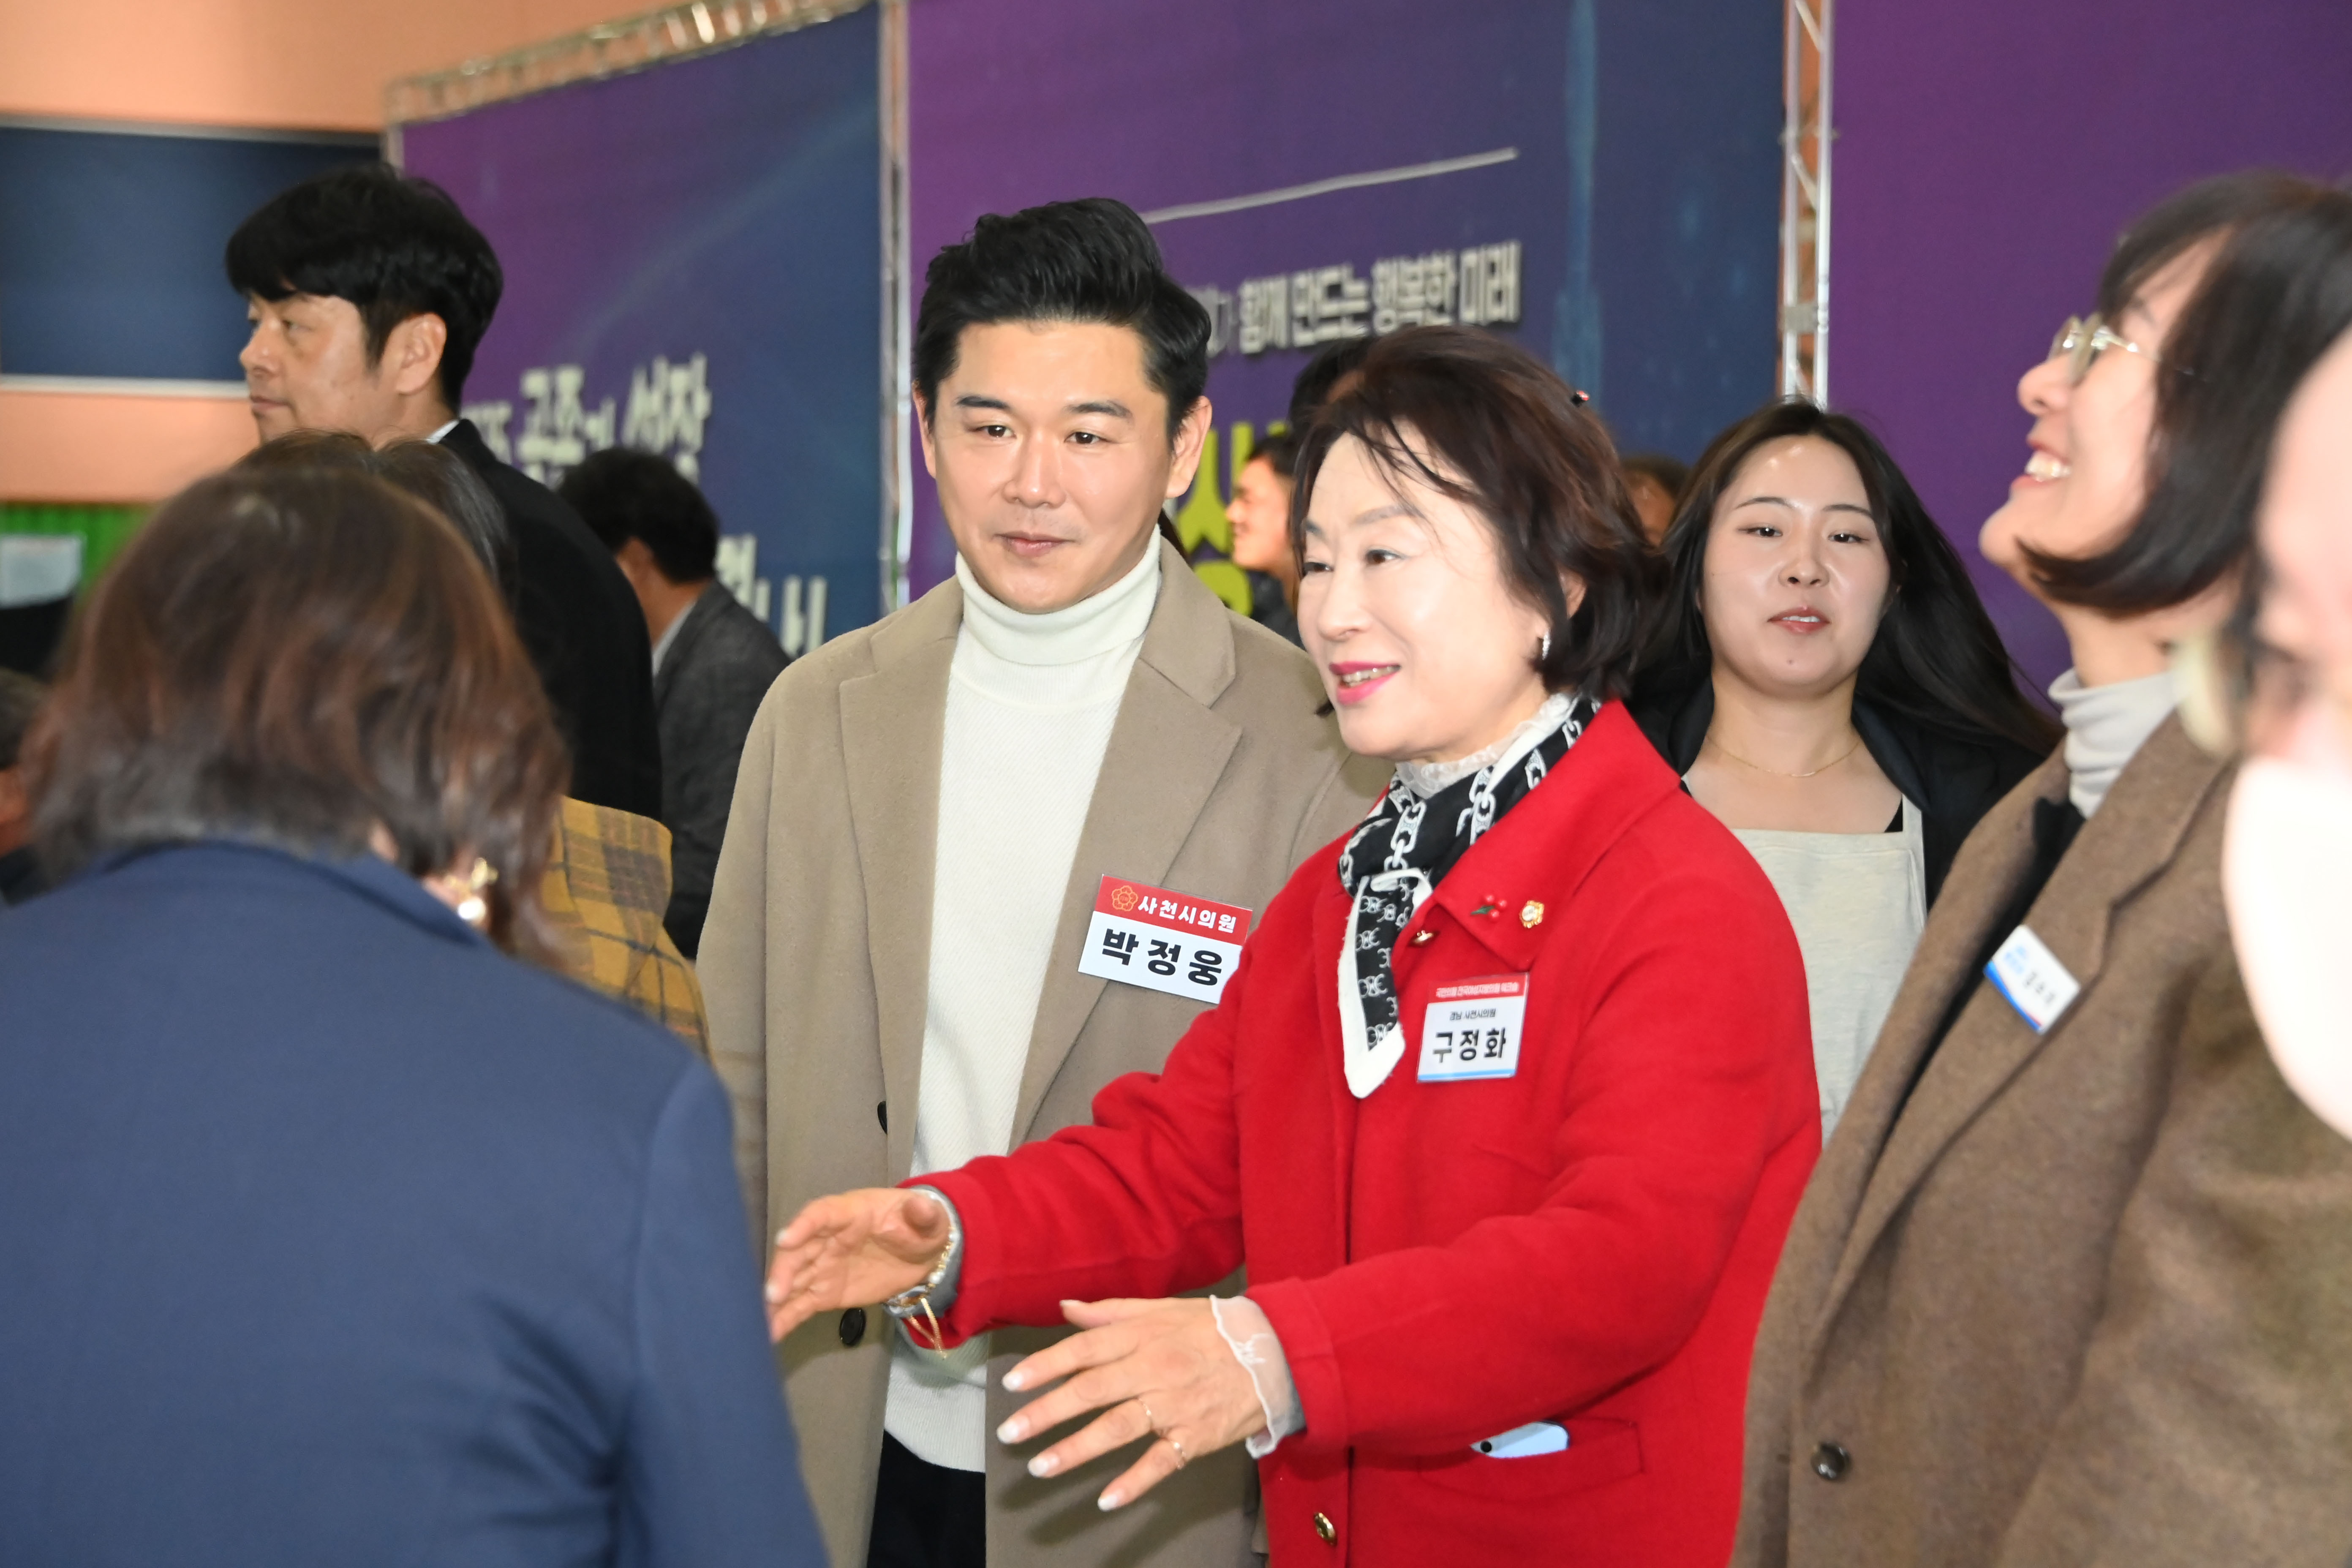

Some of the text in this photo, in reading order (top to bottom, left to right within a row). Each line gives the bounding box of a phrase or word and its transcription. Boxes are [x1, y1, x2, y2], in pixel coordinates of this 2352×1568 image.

[1238, 277, 1288, 354] 함께
[1292, 262, 1370, 348] 만드는
[1371, 250, 1456, 335] 행복한
[1459, 240, 1521, 325] 미래
[1138, 896, 1236, 933] 사천시의원
[1102, 928, 1222, 985] 박정웅
[1450, 1008, 1496, 1021] 경남 사천시의원
[1433, 1027, 1506, 1063] 구정화
